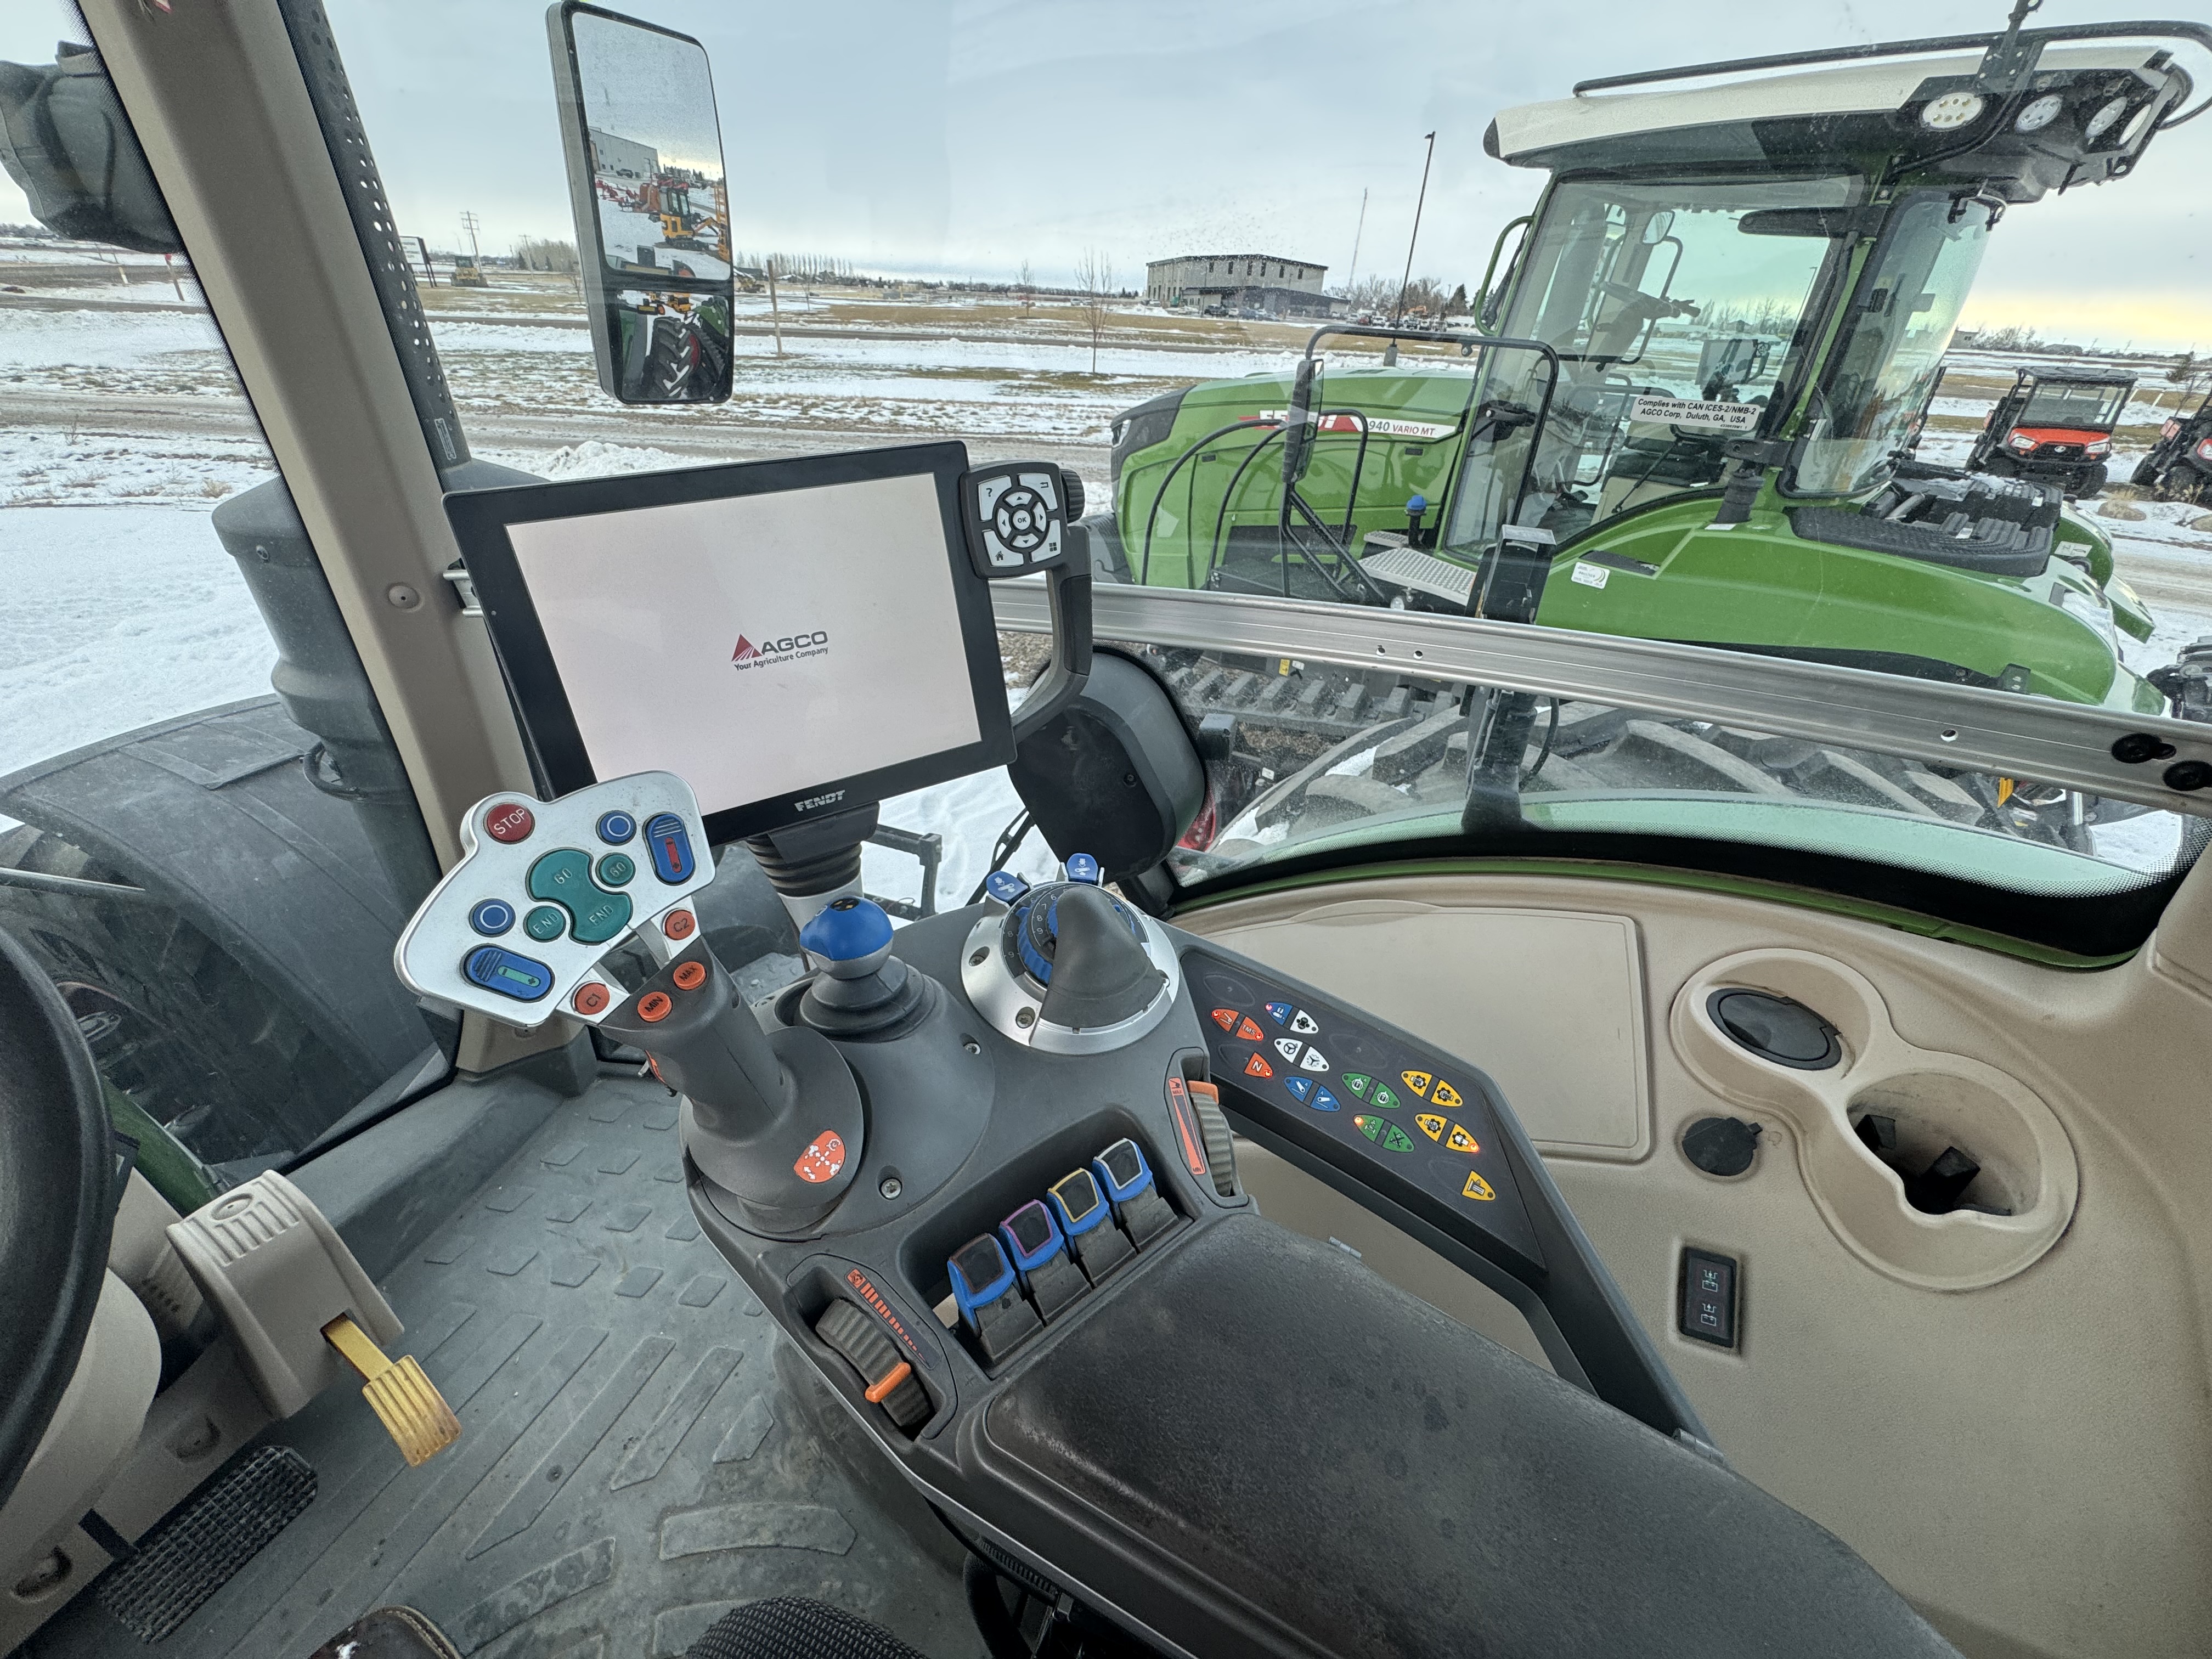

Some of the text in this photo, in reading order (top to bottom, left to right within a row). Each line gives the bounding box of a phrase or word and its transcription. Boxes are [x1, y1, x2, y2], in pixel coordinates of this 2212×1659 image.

[1638, 399, 1669, 408] Complies
[1687, 403, 1704, 411] CAN
[1705, 404, 1757, 415] ICES-2/NMB-2
[1663, 410, 1682, 419] Corp,
[1686, 412, 1711, 422] Duluth,
[1369, 420, 1436, 436] 940 VARIO MT
[761, 631, 828, 655] AGCO
[734, 647, 828, 670] Your Agriculture Company
[794, 789, 845, 812] FENDT
[493, 808, 525, 834] STOP
[554, 868, 573, 884] GO
[610, 862, 626, 877] GO
[533, 913, 560, 934] END
[589, 905, 614, 926] END
[673, 917, 690, 933] C2
[679, 965, 697, 981] MAX
[586, 993, 601, 1008] C1
[644, 995, 664, 1012] MIN
[1242, 1024, 1256, 1036] TMS
[1252, 1060, 1263, 1073] N
